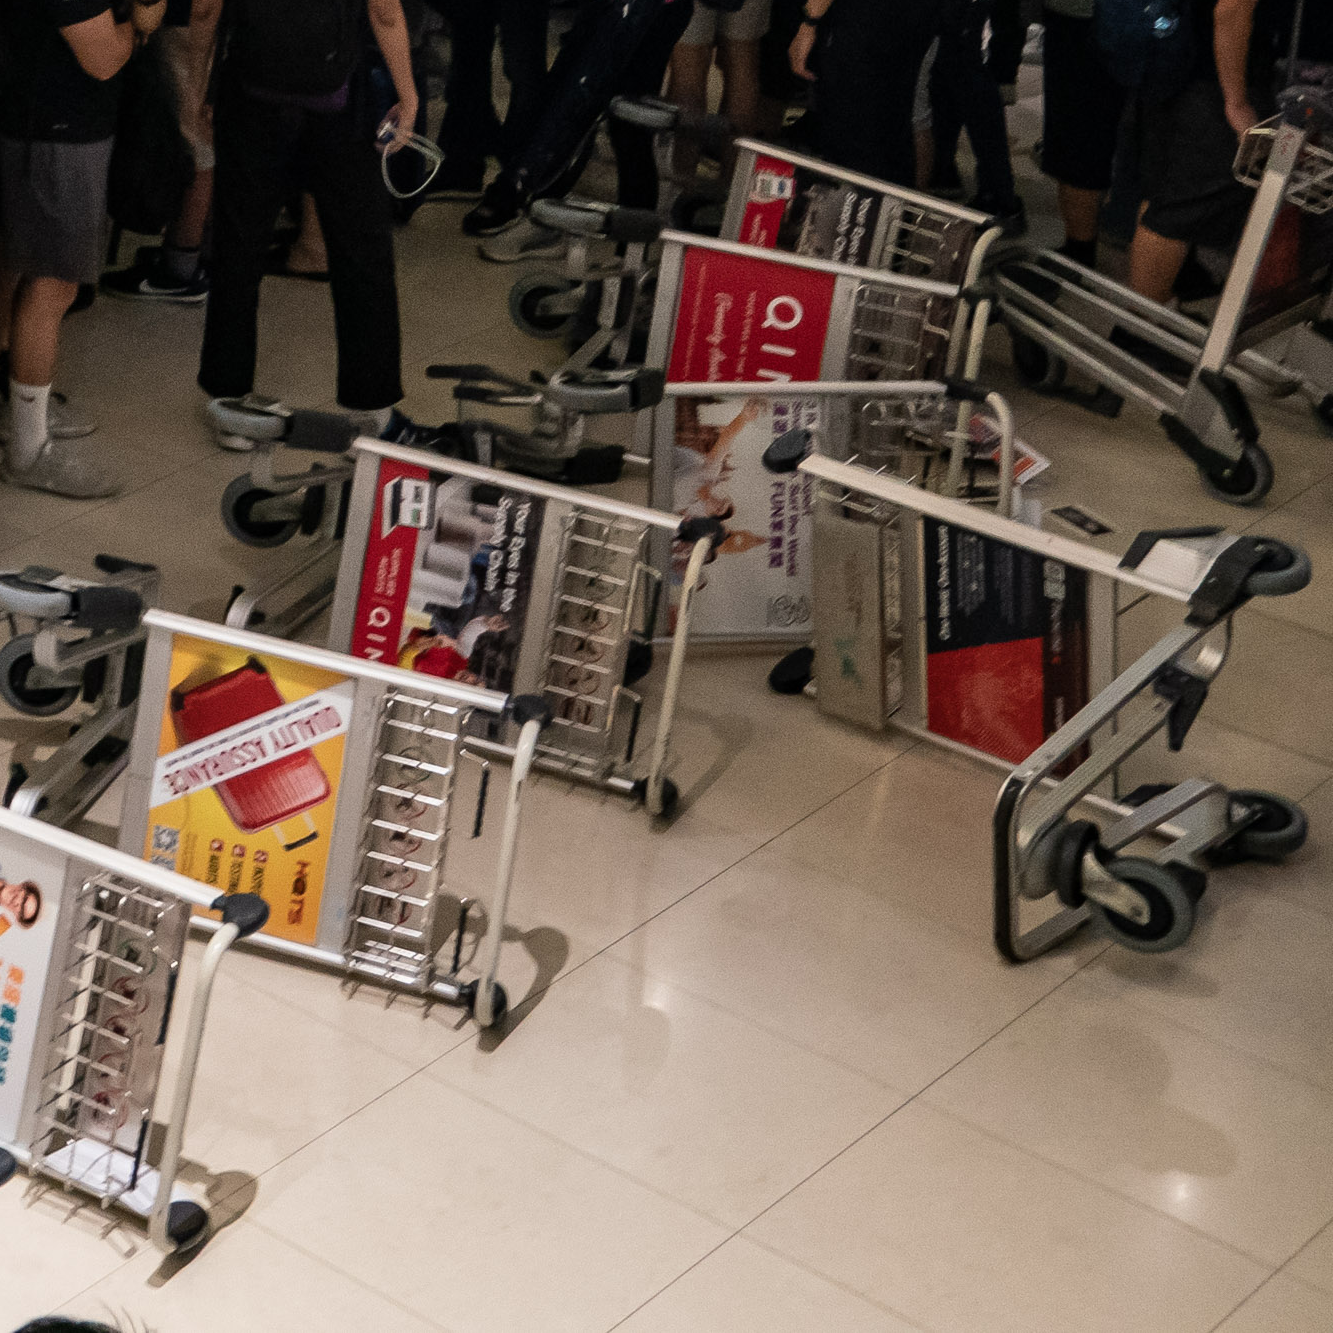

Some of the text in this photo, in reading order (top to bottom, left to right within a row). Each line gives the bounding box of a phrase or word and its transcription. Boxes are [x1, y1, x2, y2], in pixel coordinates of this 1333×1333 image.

[484, 495, 514, 592] Supply Chain
[498, 501, 532, 613] Your Eyes in the
[163, 705, 343, 796] QUALITY ASSURANCE
